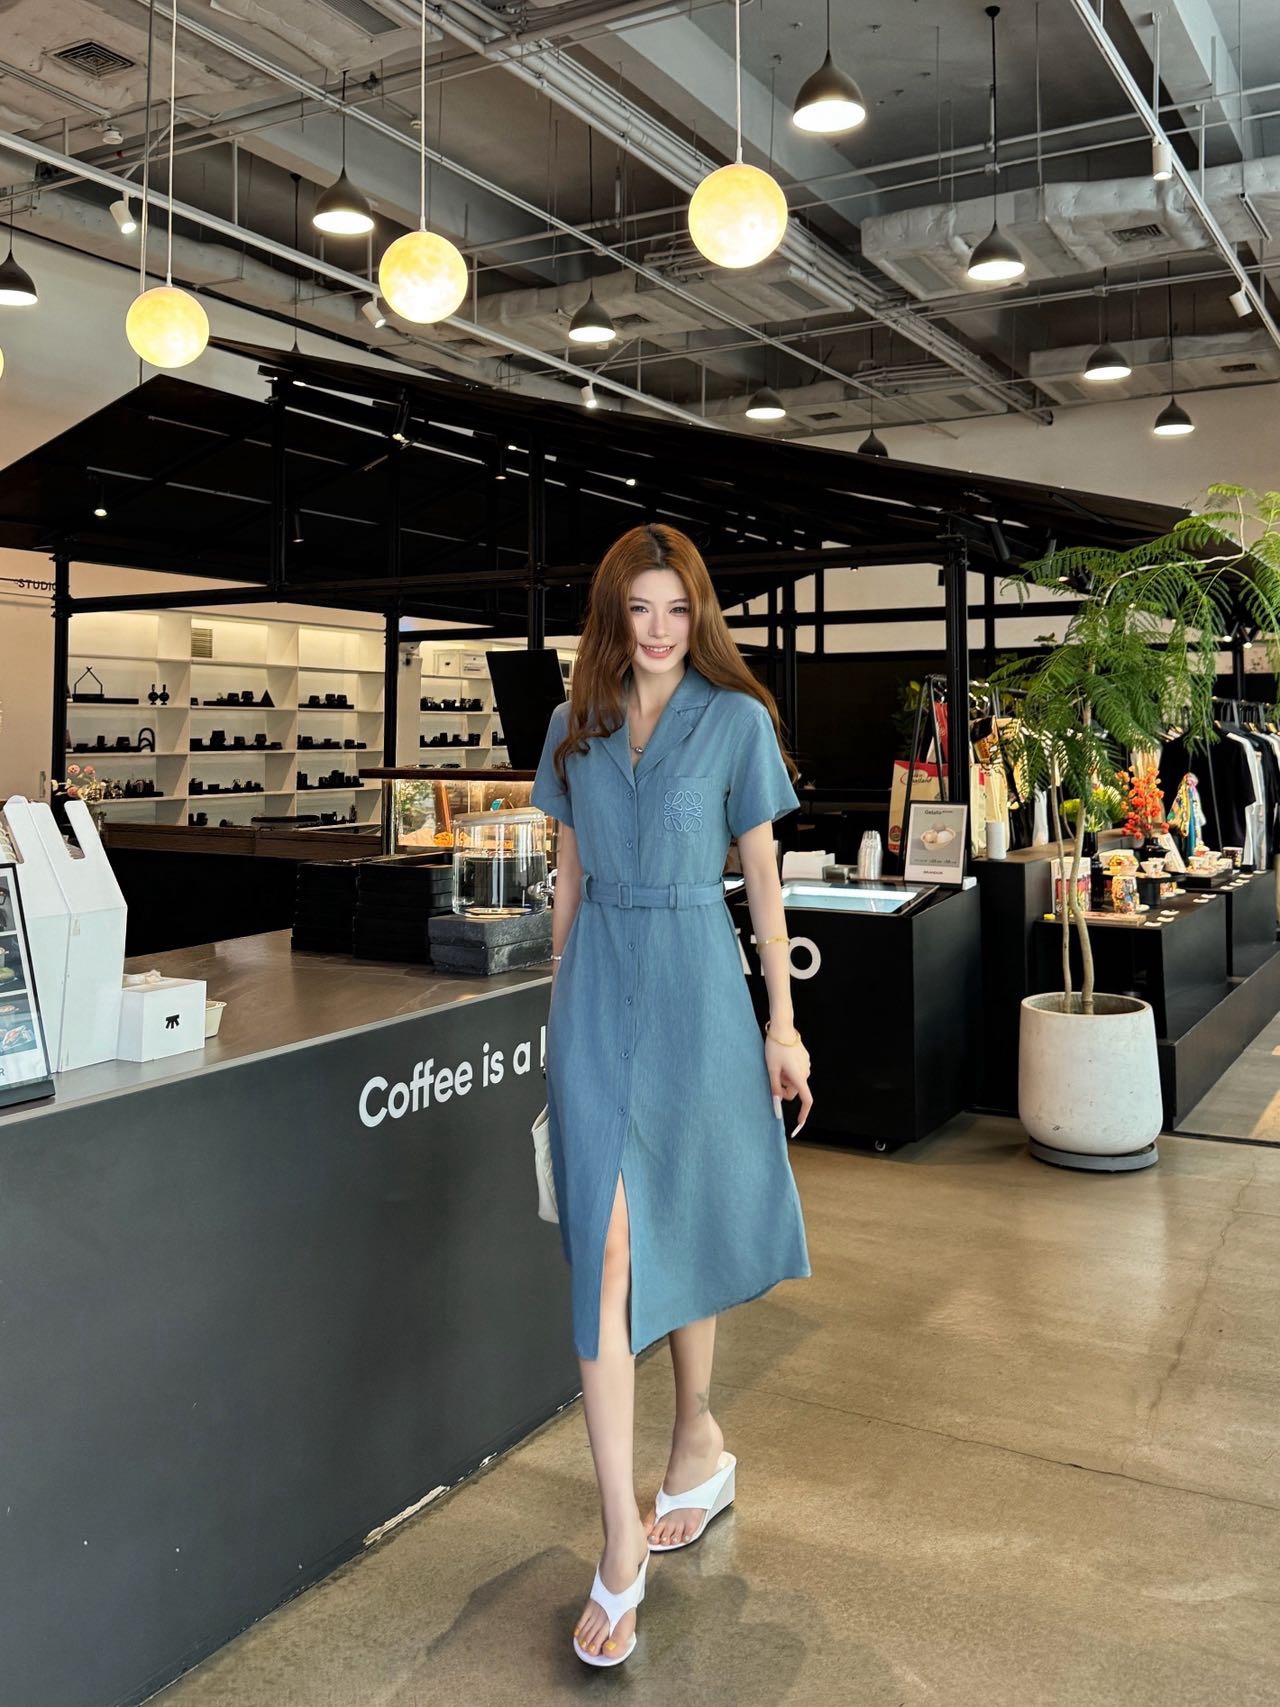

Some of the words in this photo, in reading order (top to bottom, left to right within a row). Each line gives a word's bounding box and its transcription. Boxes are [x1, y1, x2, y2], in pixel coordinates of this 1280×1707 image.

[358, 1058, 473, 1128] Coffee
[482, 1042, 504, 1088] is
[512, 1041, 531, 1076] a
